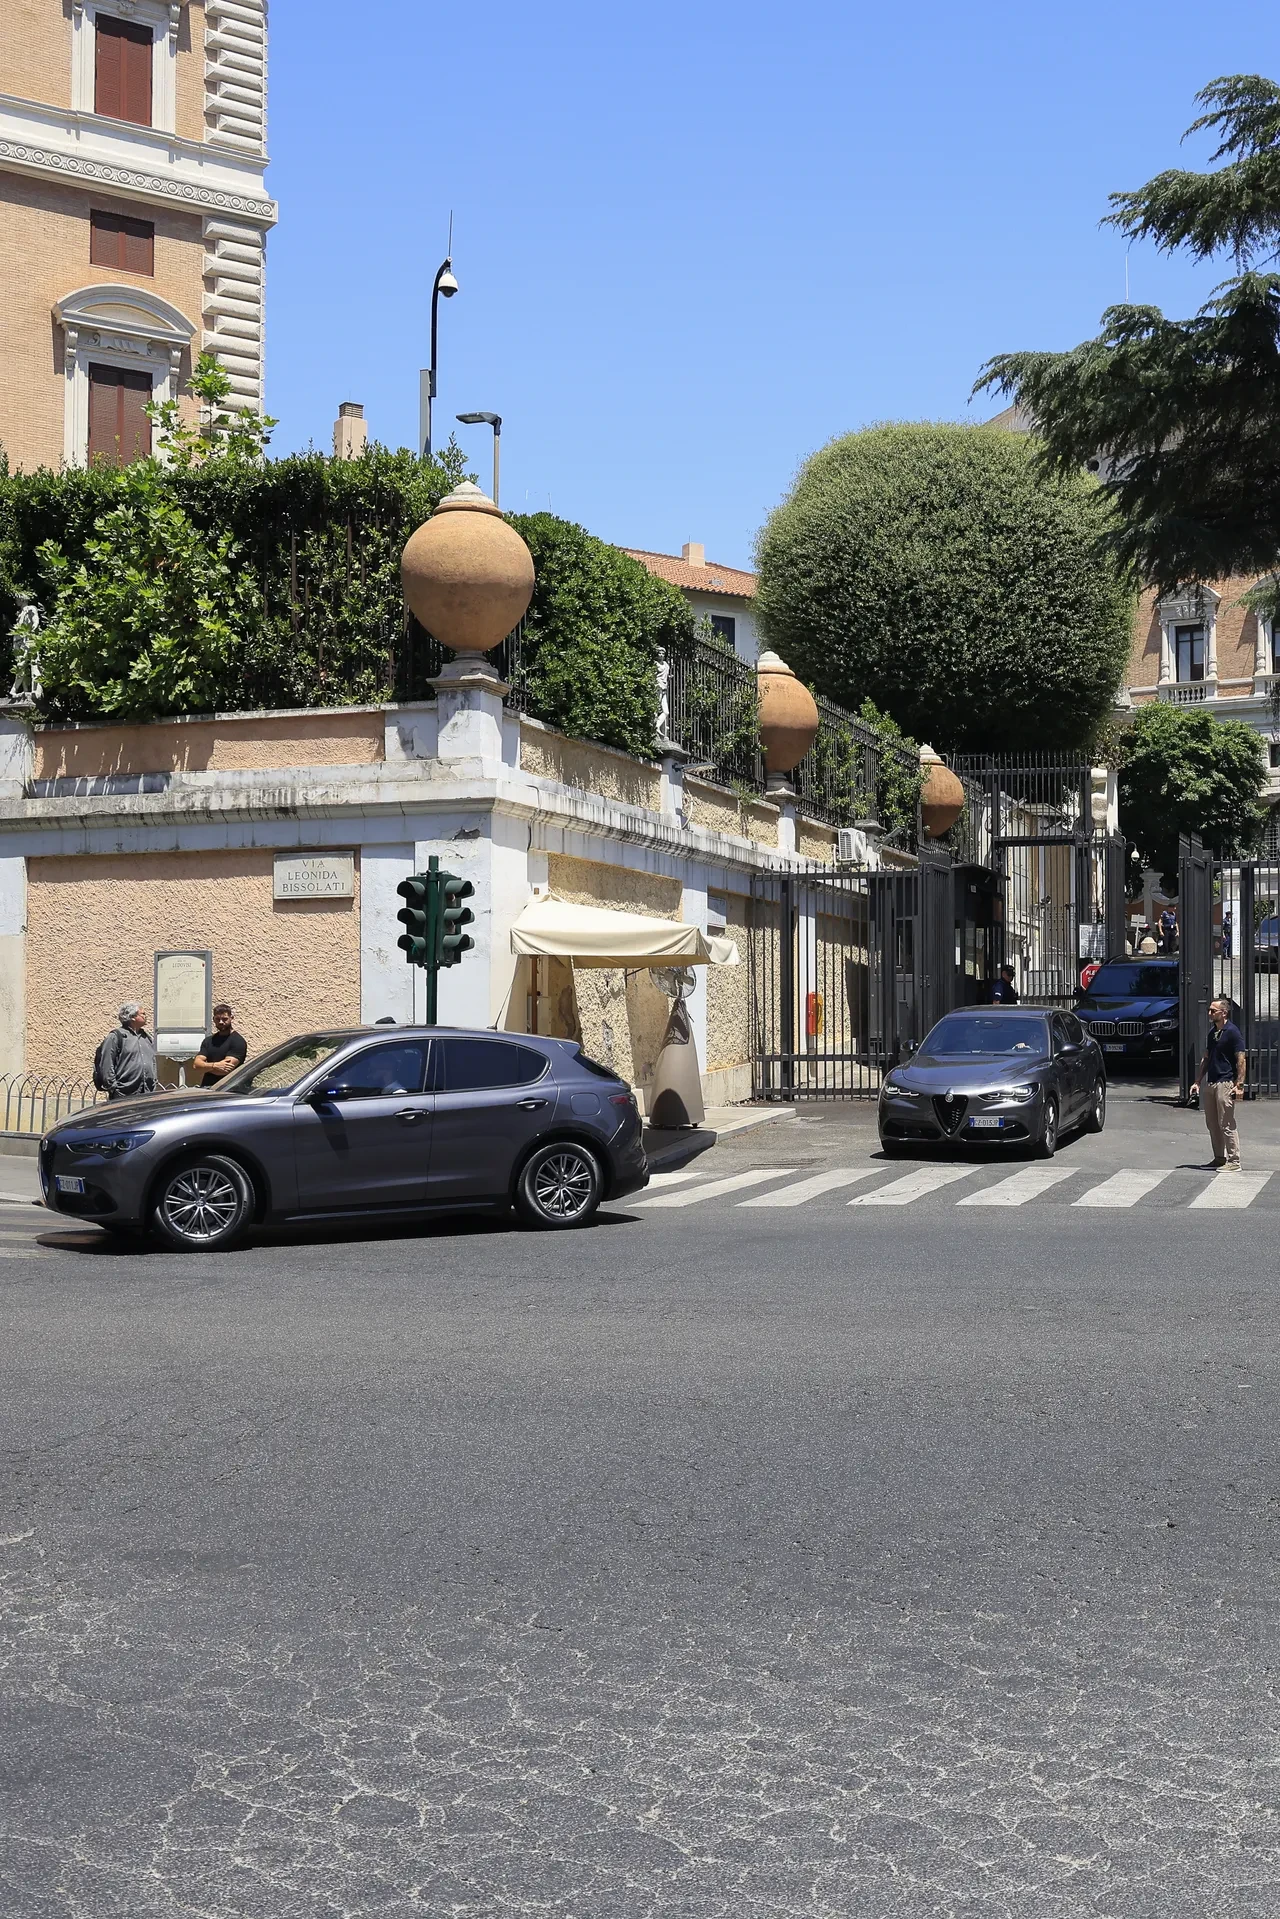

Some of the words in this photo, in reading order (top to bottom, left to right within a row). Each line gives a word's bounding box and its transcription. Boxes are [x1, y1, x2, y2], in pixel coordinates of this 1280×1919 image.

[302, 859, 325, 868] VIA
[288, 871, 338, 881] LEONIDA
[282, 882, 345, 892] BISSOLATI
